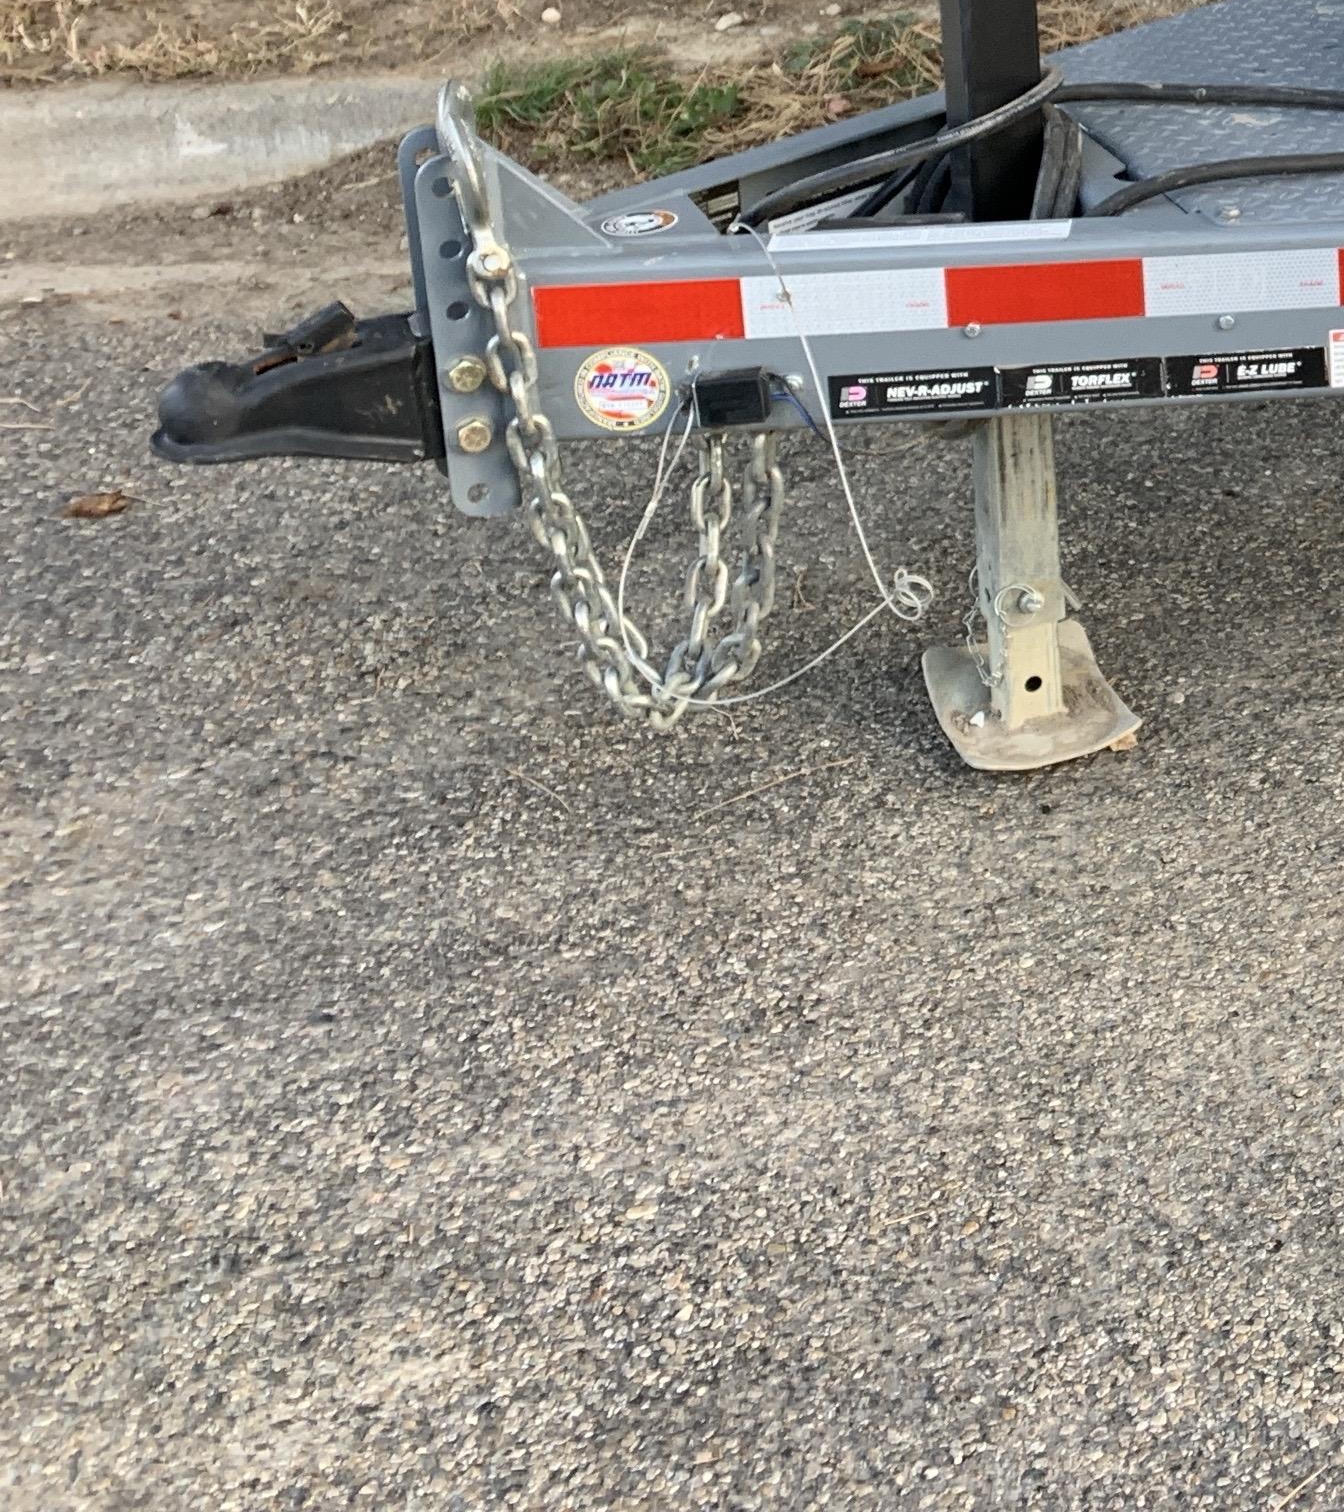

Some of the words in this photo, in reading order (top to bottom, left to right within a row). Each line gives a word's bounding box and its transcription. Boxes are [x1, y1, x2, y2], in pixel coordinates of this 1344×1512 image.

[1236, 362, 1259, 377] E-Z
[1260, 361, 1296, 375] LUBE
[1070, 372, 1131, 387] TORFLEX
[886, 381, 984, 398] NEV-R-ADJUST
